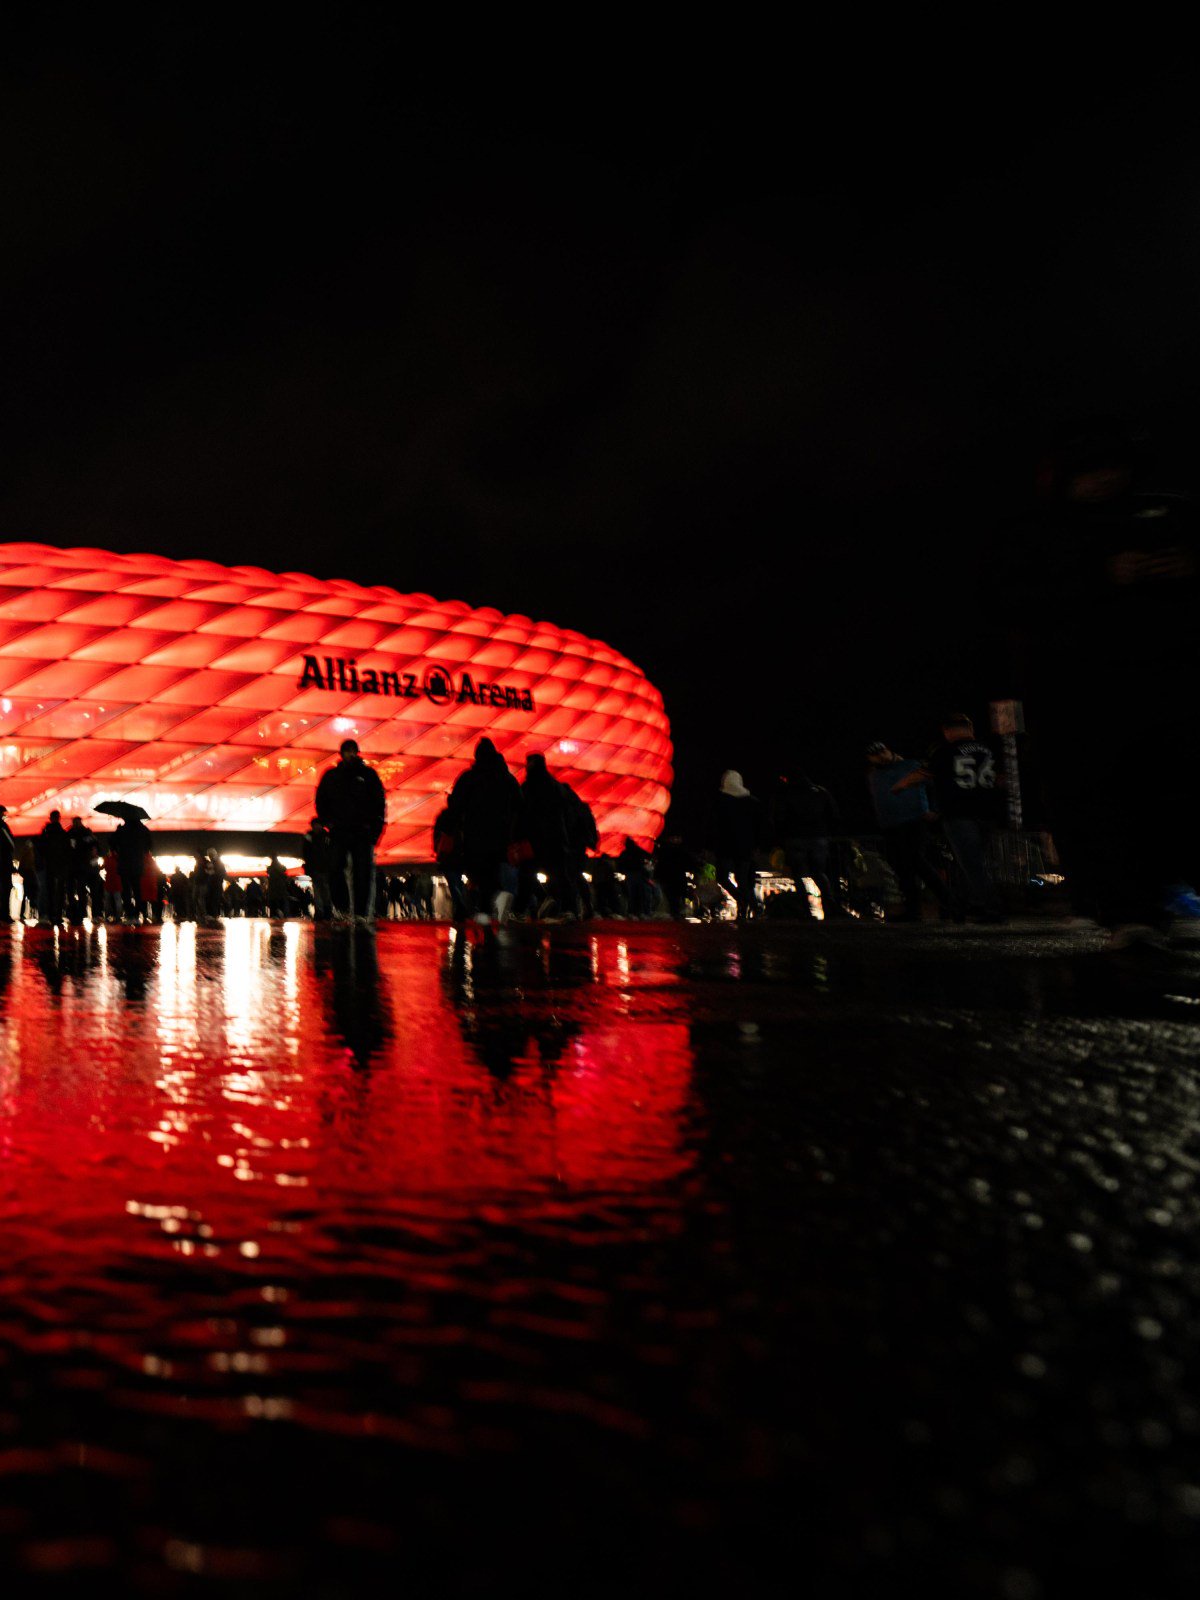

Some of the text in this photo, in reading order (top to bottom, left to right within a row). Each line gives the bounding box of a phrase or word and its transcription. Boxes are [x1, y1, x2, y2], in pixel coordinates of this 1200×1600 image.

[298, 654, 535, 711] Allianz Arena
[953, 755, 996, 790] 56
